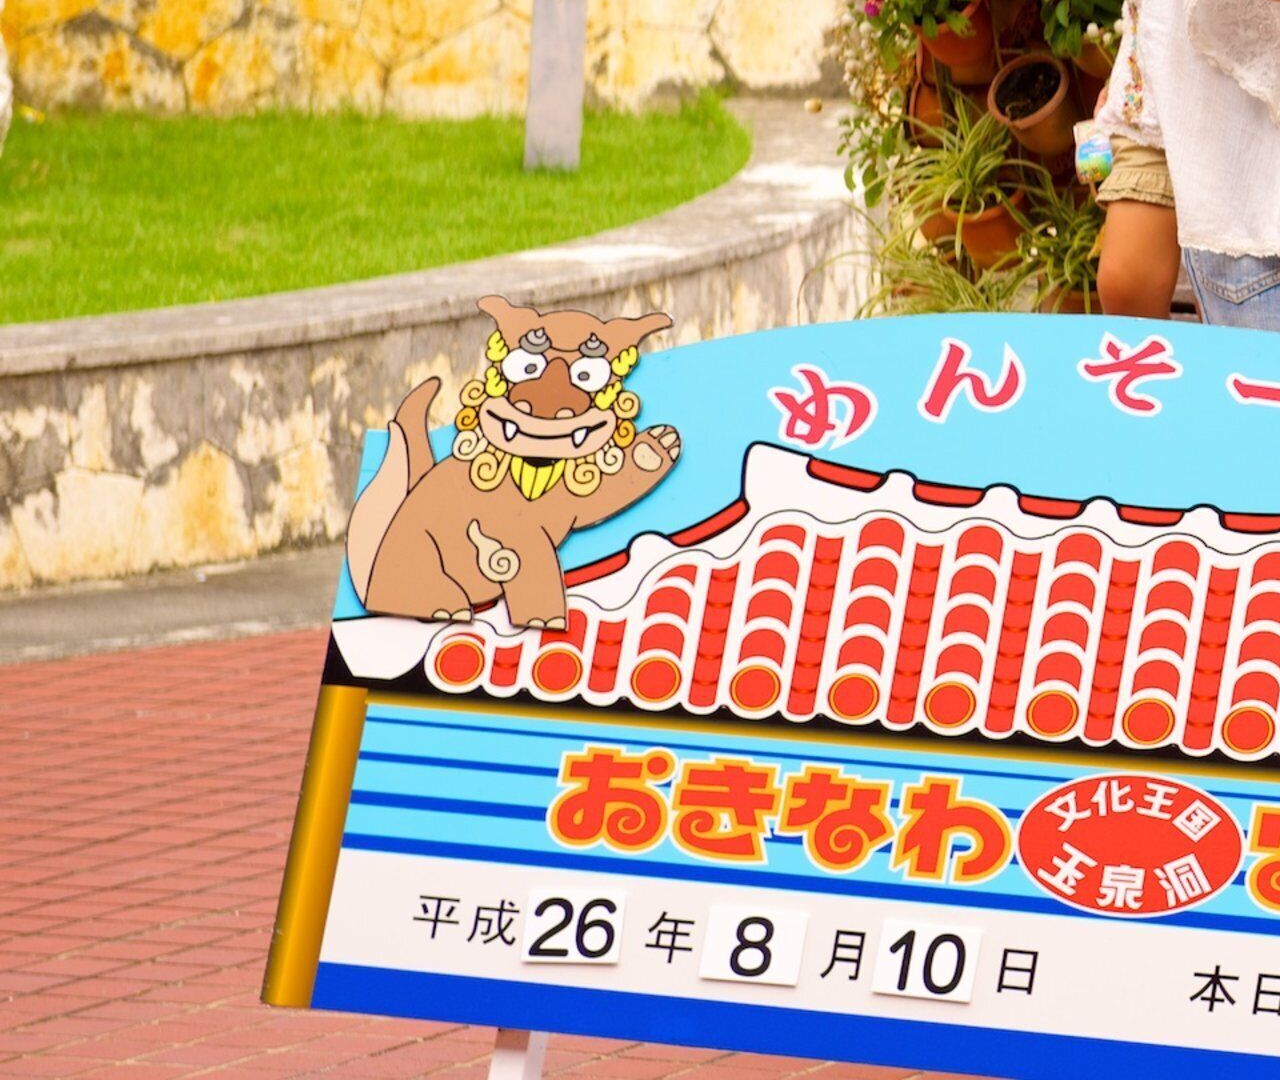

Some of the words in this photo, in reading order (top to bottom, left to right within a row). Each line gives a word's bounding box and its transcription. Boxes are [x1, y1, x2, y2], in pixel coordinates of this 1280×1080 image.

[546, 745, 1015, 885] おきなわ
[1044, 780, 1222, 843] 文化王国
[1037, 842, 1212, 909] 玉泉洞
